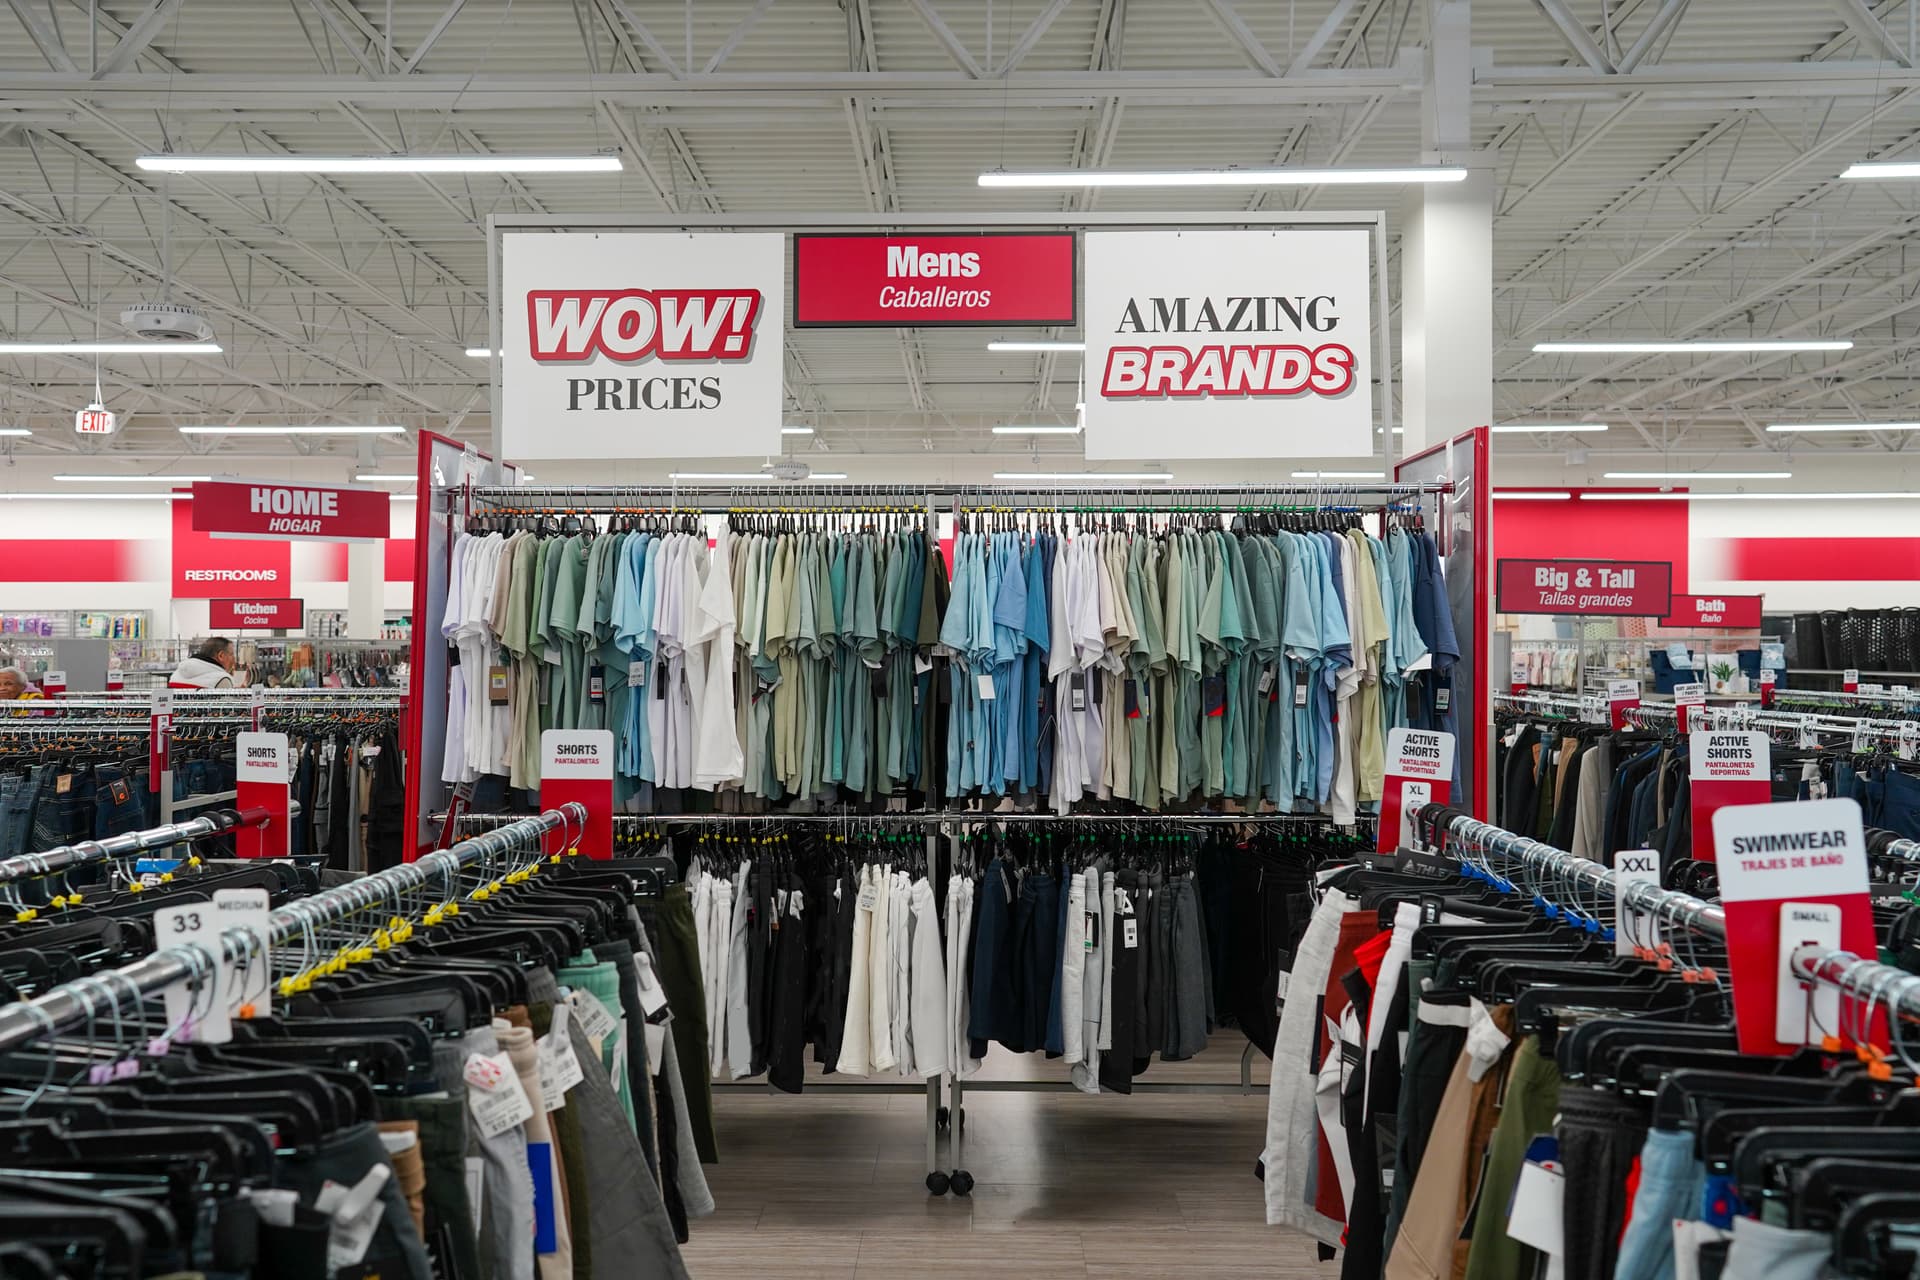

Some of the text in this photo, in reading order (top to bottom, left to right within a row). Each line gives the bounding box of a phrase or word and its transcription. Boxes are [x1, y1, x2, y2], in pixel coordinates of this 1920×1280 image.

[886, 246, 981, 278] Mens
[878, 285, 992, 309] Caballeros
[1114, 296, 1341, 334] AMAZING
[534, 296, 751, 354] WOW!
[1106, 348, 1350, 393] BRANDS
[566, 377, 722, 411] PRICES
[82, 412, 107, 432] EXIT
[250, 488, 338, 516] HOME
[268, 518, 321, 533] HOGAR
[185, 569, 277, 581] RESTROOMS
[1535, 567, 1635, 591] Big & Tall
[1539, 591, 1633, 608] Tallas grandes
[1696, 599, 1726, 612] Bath
[233, 602, 278, 615] Kitchen
[243, 616, 268, 625] Cocina
[1701, 614, 1722, 623] Baño
[1405, 733, 1439, 746] ACTIVE
[1709, 735, 1749, 747] ACTIVE
[247, 746, 277, 760] SHORTS
[557, 744, 598, 755] SHORTS
[1402, 745, 1440, 758] SHORTS
[1707, 748, 1752, 759] SHORTS
[245, 760, 278, 769] PANTALONETAS
[554, 757, 599, 765] PANTALONETAS
[1399, 758, 1440, 768] PANTALONETAS
[1705, 761, 1755, 769] PANTALONETAS
[1402, 766, 1436, 775] DEPORTIVAS
[1710, 768, 1751, 776] DEPORTIVAS
[1409, 785, 1424, 796] XL
[1733, 830, 1846, 855] SWIMWEAR
[1622, 857, 1656, 873] XXL
[1741, 853, 1844, 871] TRAJES DE BAÑO
[217, 900, 264, 911] MEDIUM
[1792, 911, 1830, 922] SMALL
[173, 914, 201, 933] 33
